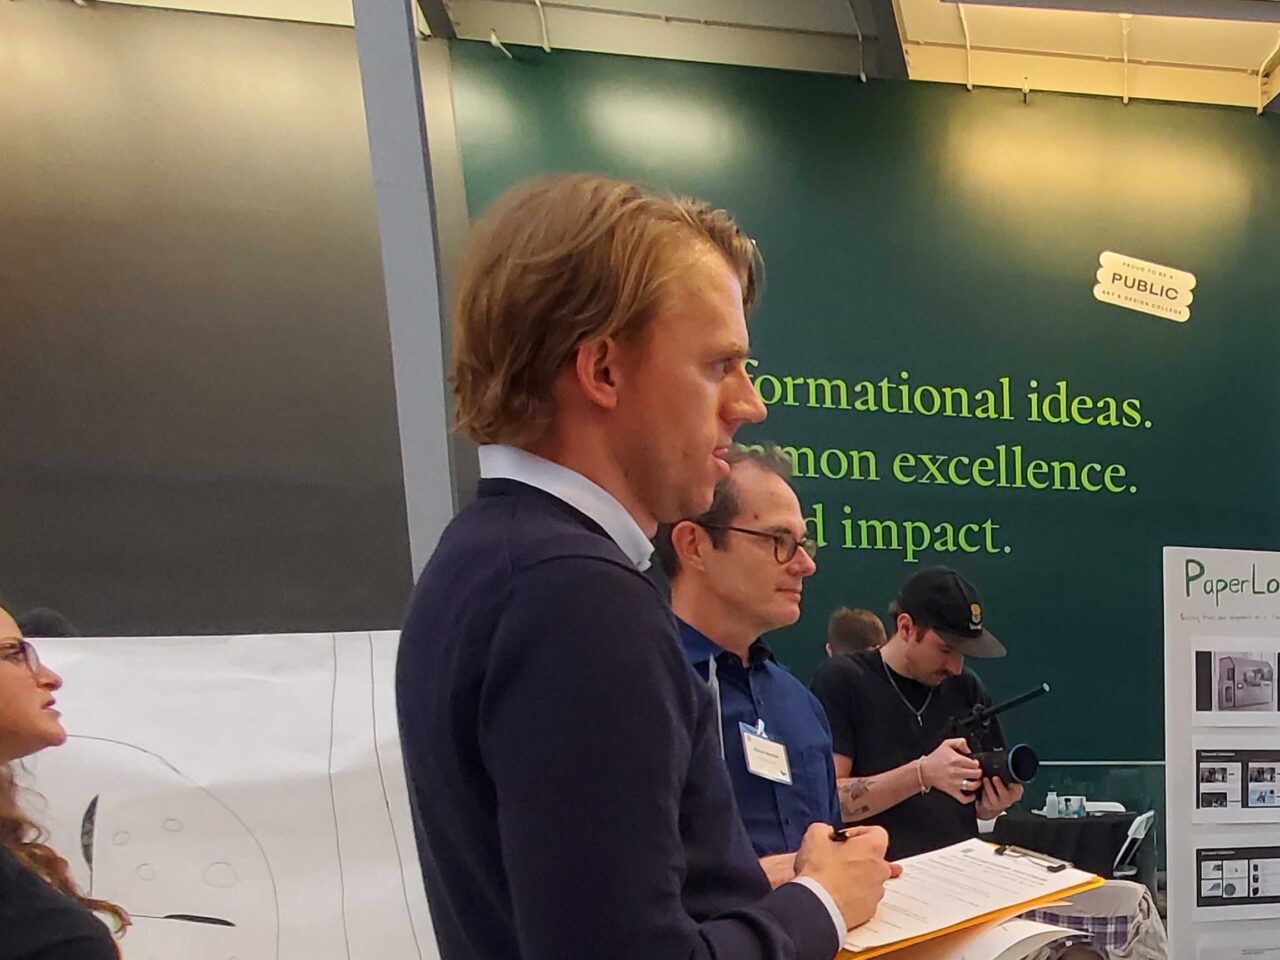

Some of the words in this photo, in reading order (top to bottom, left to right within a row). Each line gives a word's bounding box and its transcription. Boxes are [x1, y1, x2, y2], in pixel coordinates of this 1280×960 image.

[1111, 272, 1179, 300] PUBLIC
[1151, 302, 1183, 315] COLLEGE
[1027, 379, 1153, 429] ideas.
[892, 444, 1138, 494] excellence.
[840, 504, 1012, 563] impact.
